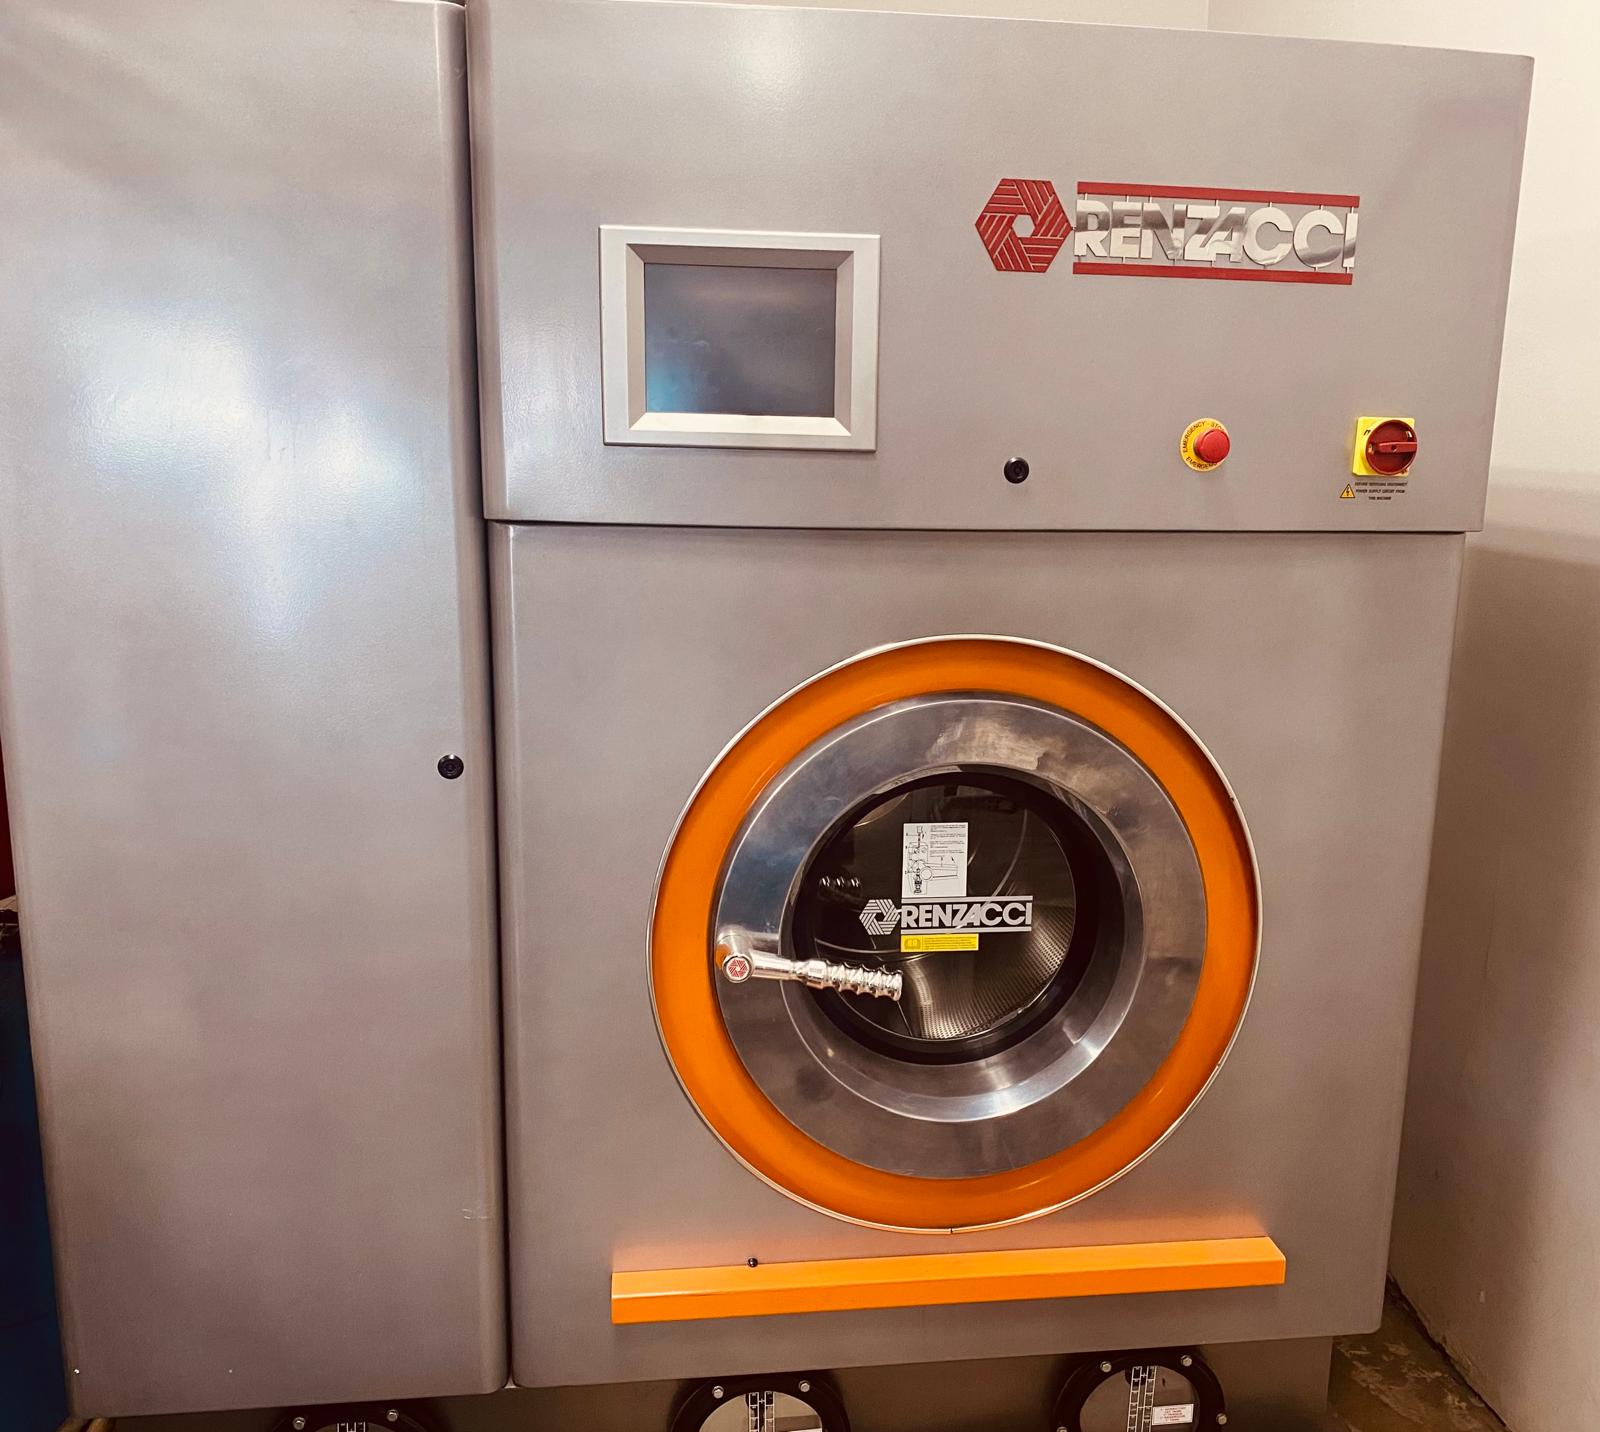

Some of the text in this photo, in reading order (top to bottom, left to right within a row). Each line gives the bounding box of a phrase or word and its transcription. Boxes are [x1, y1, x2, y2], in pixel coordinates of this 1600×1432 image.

[1073, 198, 1359, 269] RENZACCI
[1182, 421, 1206, 453] EMERGENCY
[901, 902, 1033, 928] RENZACCI
